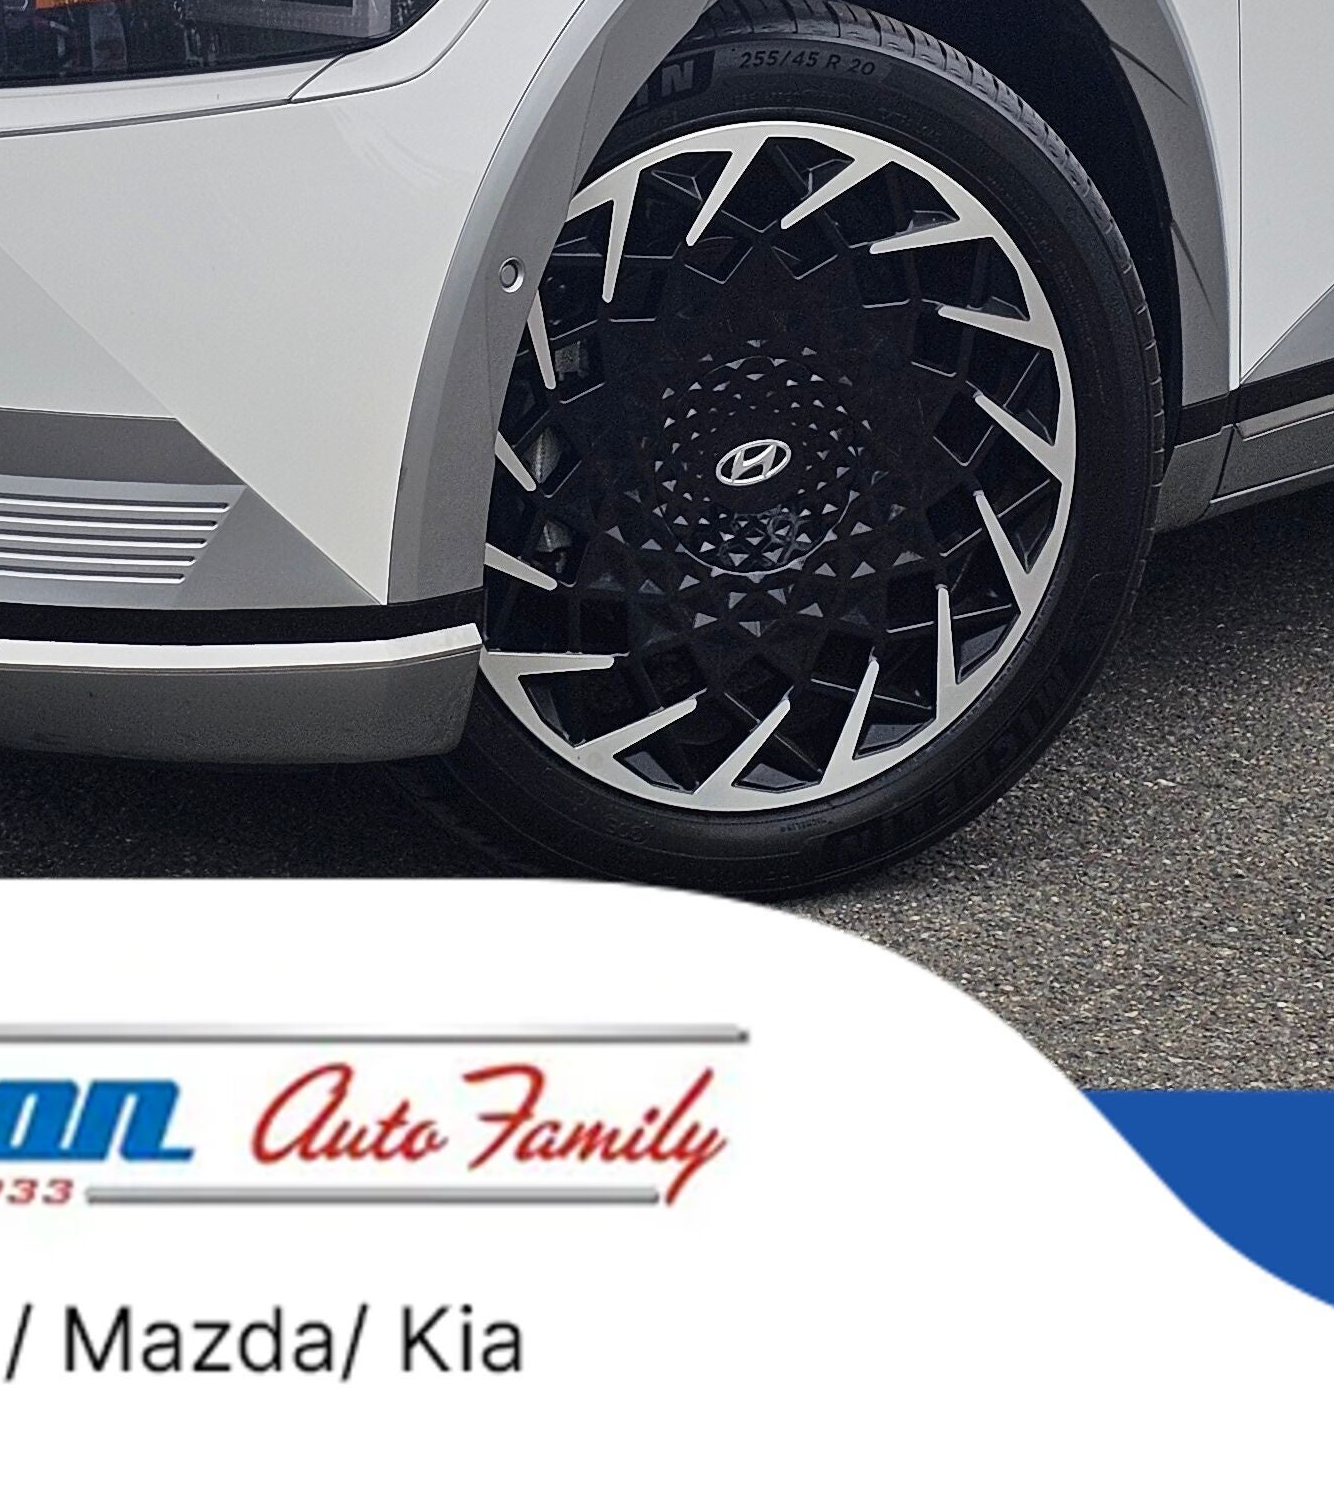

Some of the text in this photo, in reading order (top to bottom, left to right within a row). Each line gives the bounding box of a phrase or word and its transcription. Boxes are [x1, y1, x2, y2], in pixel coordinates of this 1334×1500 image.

[738, 49, 876, 76] 255/45 R 20
